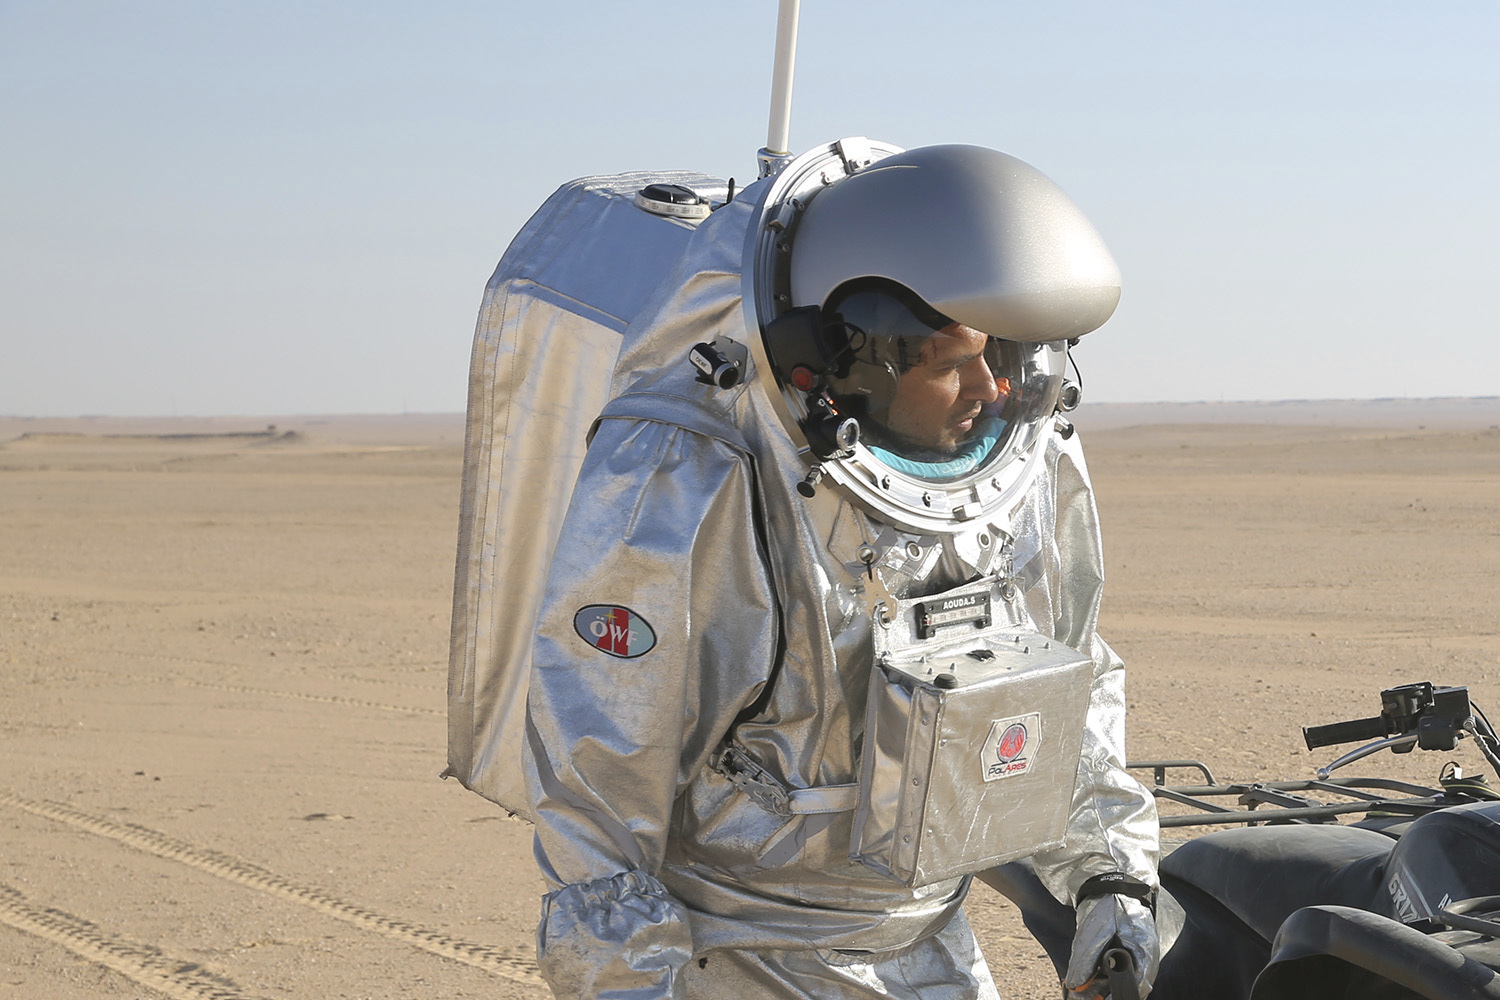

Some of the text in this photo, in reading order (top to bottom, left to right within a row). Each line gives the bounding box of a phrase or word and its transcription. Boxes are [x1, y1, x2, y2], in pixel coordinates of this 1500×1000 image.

[942, 595, 976, 610] AOUDA.S
[589, 614, 639, 648] ÖWF
[1388, 871, 1421, 923] GRIZ
